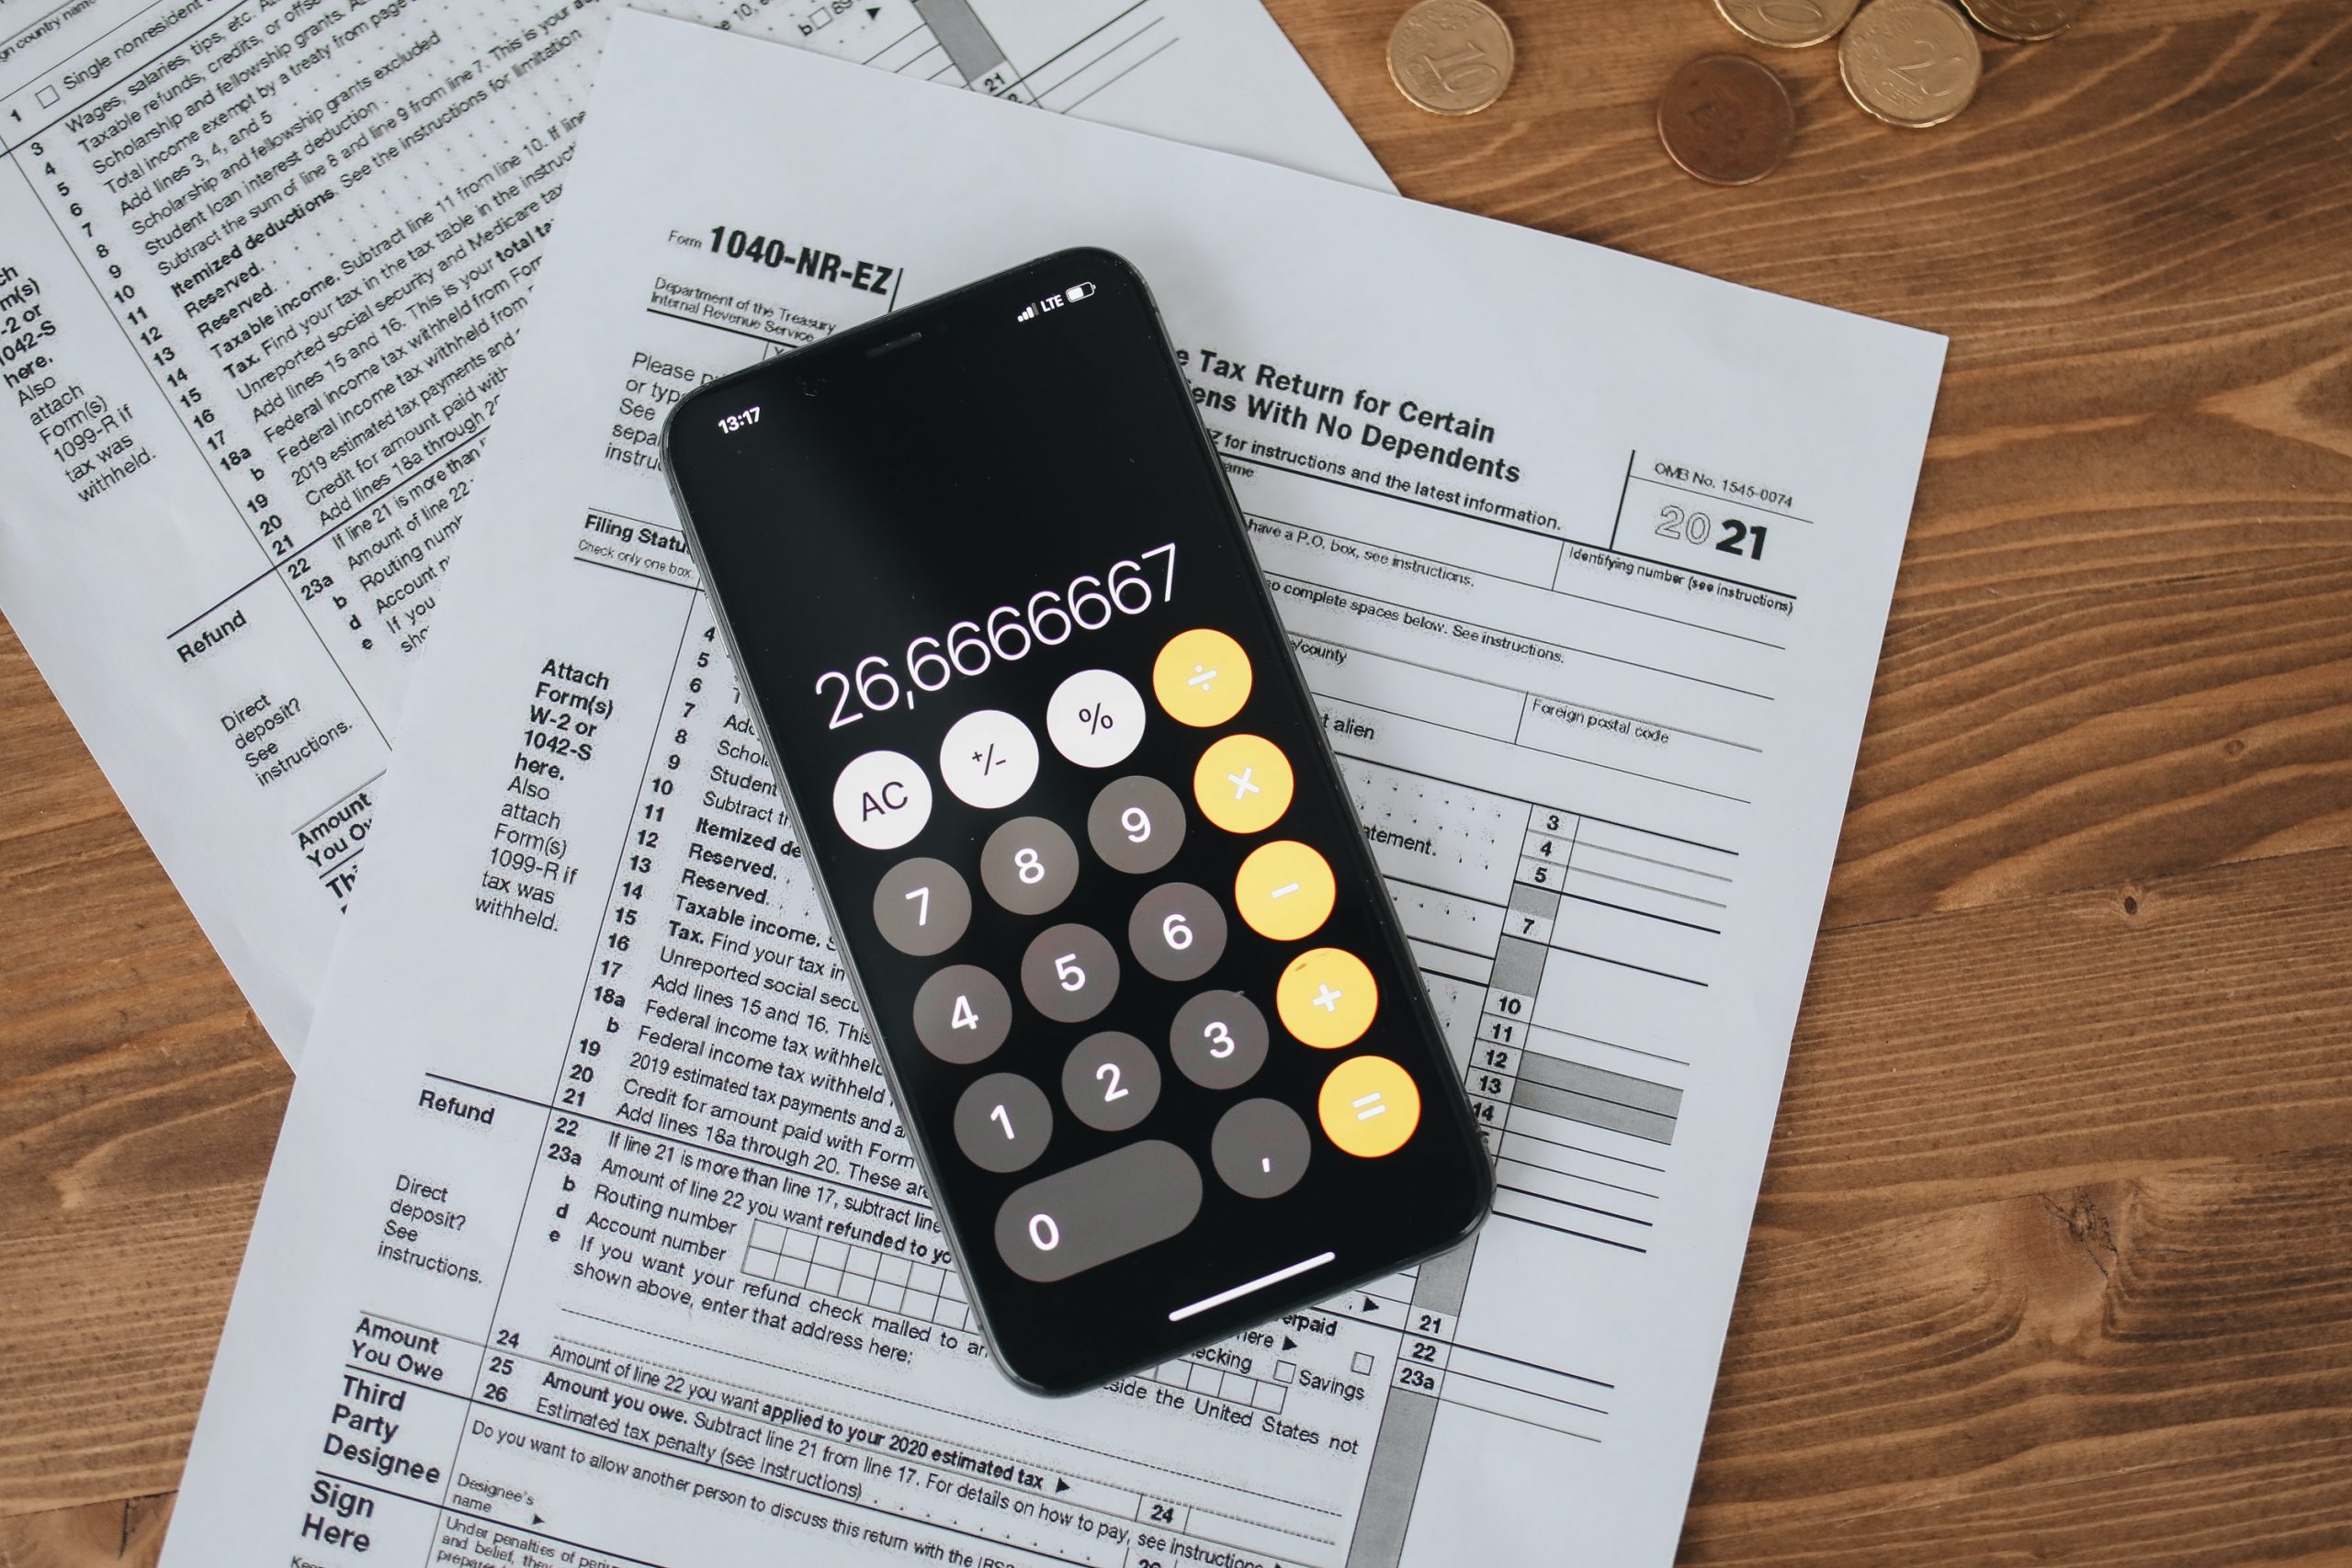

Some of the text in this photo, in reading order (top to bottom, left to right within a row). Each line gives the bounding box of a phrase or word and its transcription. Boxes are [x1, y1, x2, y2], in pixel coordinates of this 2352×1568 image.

[62, 0, 203, 90] Single nonresident
[131, 29, 442, 235] Scholarship and fellowship grants excluded
[144, 101, 379, 256] Student loan interest deduction
[170, 29, 582, 298] Itemized deductions. See the instructions for limitation
[668, 225, 894, 294] Form 1040-NR-EZ
[650, 291, 813, 341] Internal Revenue Service
[654, 276, 836, 334] Department of the Treasury
[1040, 294, 1064, 312] LTE
[631, 351, 695, 381] Please
[626, 378, 648, 394] or
[1200, 349, 1495, 444] Tax Return for Certain
[619, 398, 655, 421] See
[718, 406, 763, 434] 13:17
[1248, 394, 1521, 483] With No Dependents
[1226, 434, 1561, 531] for instructions and the latest information.
[1654, 462, 1792, 508] OMB No. 1545-0074
[584, 513, 634, 543] Filing
[1654, 504, 1768, 561] 2021
[578, 539, 666, 571] Check only one
[1296, 530, 1325, 550] P.O.
[1391, 558, 1474, 587] instructions.
[1569, 547, 1793, 616] Identifying number (see instructions)
[176, 609, 247, 663] Refund
[816, 543, 1176, 730] 26,6666667
[1283, 584, 1564, 663] complete spaces below. See instructions.
[540, 659, 610, 691] Attach
[220, 694, 271, 733] Direct
[535, 681, 614, 720] Form(s)
[1079, 703, 1113, 735] %
[234, 697, 301, 750] deposit?
[530, 704, 598, 738] W-2 or
[1333, 717, 1375, 740] alien
[1532, 698, 1669, 744] Foreign postal code
[244, 742, 278, 768] See
[257, 722, 353, 787] instructions.
[524, 729, 593, 761] 1042-S
[514, 751, 564, 781] here.
[506, 775, 550, 801] Also
[863, 782, 907, 821] AC
[501, 803, 560, 830] attach
[695, 817, 777, 852] Itemized
[1121, 807, 1151, 843] 9
[493, 822, 567, 860] Form(s)
[491, 847, 579, 886] 1099-R if
[1014, 848, 1046, 885] 8
[481, 870, 555, 905] tax was
[905, 886, 930, 927] 7
[475, 897, 559, 932] withheld.
[676, 894, 820, 947] Taxable income.
[1162, 913, 1193, 950] 6
[1055, 953, 1086, 992] 5
[951, 995, 979, 1030] 4
[1498, 996, 1521, 1015] 10
[1204, 1021, 1235, 1058] 3
[1487, 1049, 1508, 1069] 12
[638, 1024, 886, 1103] Federal income tax withheld
[1096, 1063, 1129, 1102] 2
[418, 1089, 496, 1125] Refund
[623, 1077, 915, 1168] Credit for amount paid with Form
[990, 1104, 1015, 1140] 1
[395, 1174, 448, 1203] Direct
[383, 1219, 418, 1243] See
[390, 1199, 467, 1231] deposit?
[1029, 1213, 1059, 1251] 0
[377, 1244, 482, 1284] instructions.
[355, 1316, 440, 1355] Amount
[352, 1338, 444, 1382] You Owe
[1399, 1367, 1435, 1391] 23a
[343, 1374, 407, 1412] Third
[1298, 1369, 1365, 1402] Savings
[331, 1403, 400, 1445] Party
[549, 1344, 1044, 1490] Amount of line 22 you want applied to your 2020 estimated tax
[1156, 1388, 1359, 1455] the United States not
[322, 1432, 440, 1483] Designee
[310, 1480, 375, 1518] Sign
[300, 1512, 370, 1552] Here
